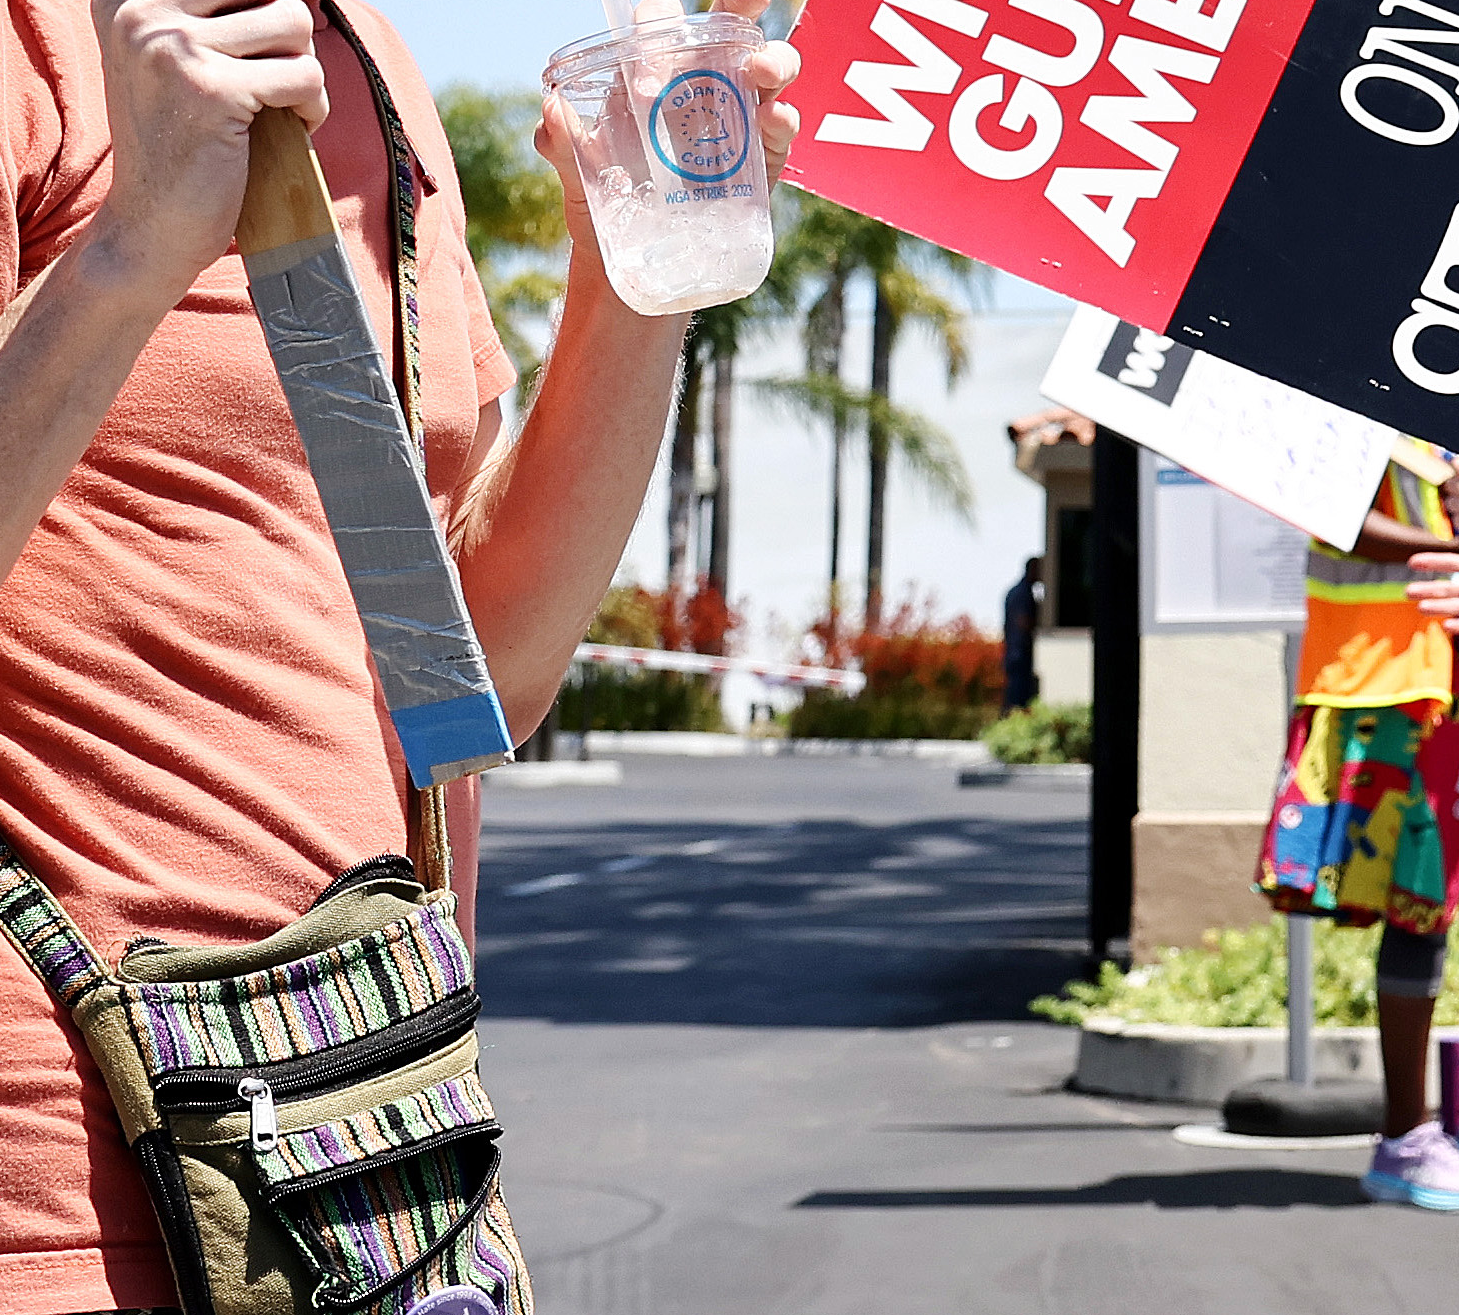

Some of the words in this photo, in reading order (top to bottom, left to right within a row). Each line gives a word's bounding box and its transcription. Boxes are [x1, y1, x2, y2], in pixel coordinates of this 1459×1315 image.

[681, 146, 736, 167] COFFEE
[665, 190, 690, 204] WGA
[693, 185, 729, 201] STRIKE
